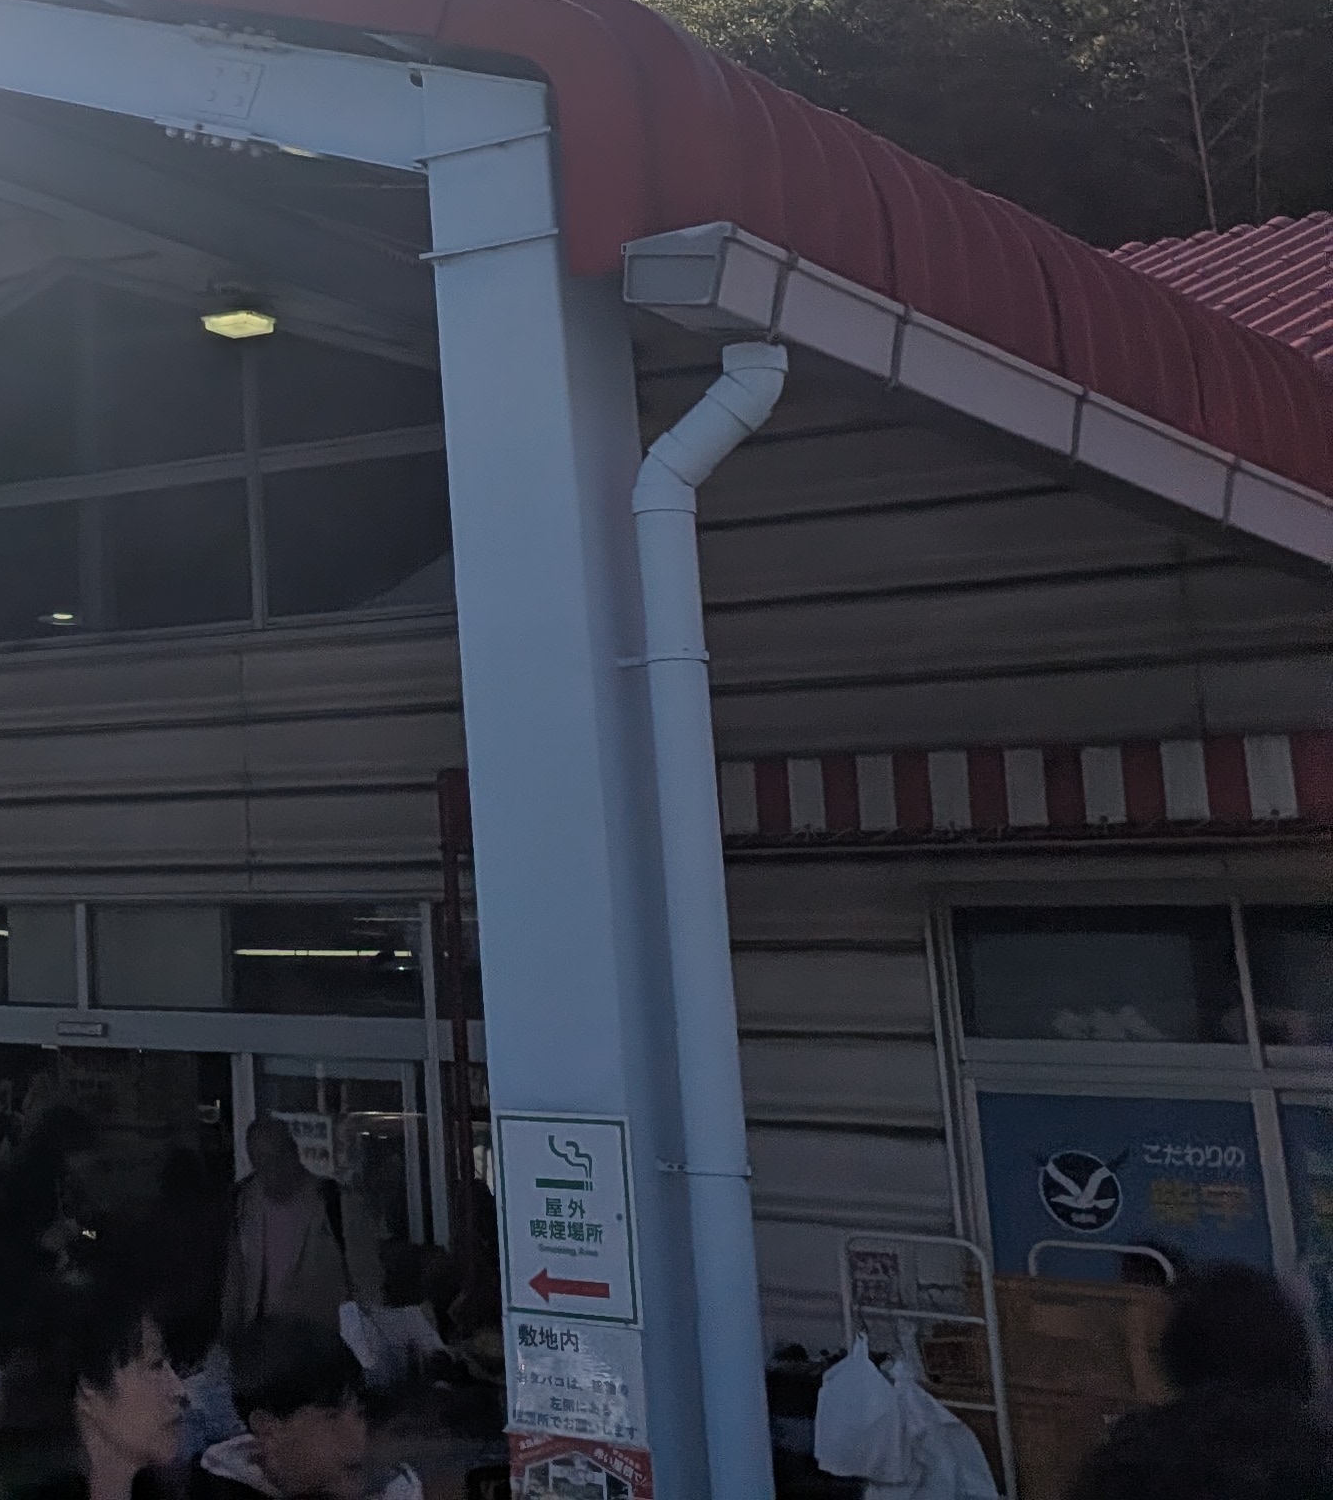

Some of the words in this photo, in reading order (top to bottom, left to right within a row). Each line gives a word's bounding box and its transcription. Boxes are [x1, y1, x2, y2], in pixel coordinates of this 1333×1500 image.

[1141, 1143, 1247, 1168] こだわりの
[545, 1196, 587, 1220] 屋外
[529, 1218, 604, 1245] 喫煙場所
[518, 1324, 580, 1353] 敷地内
